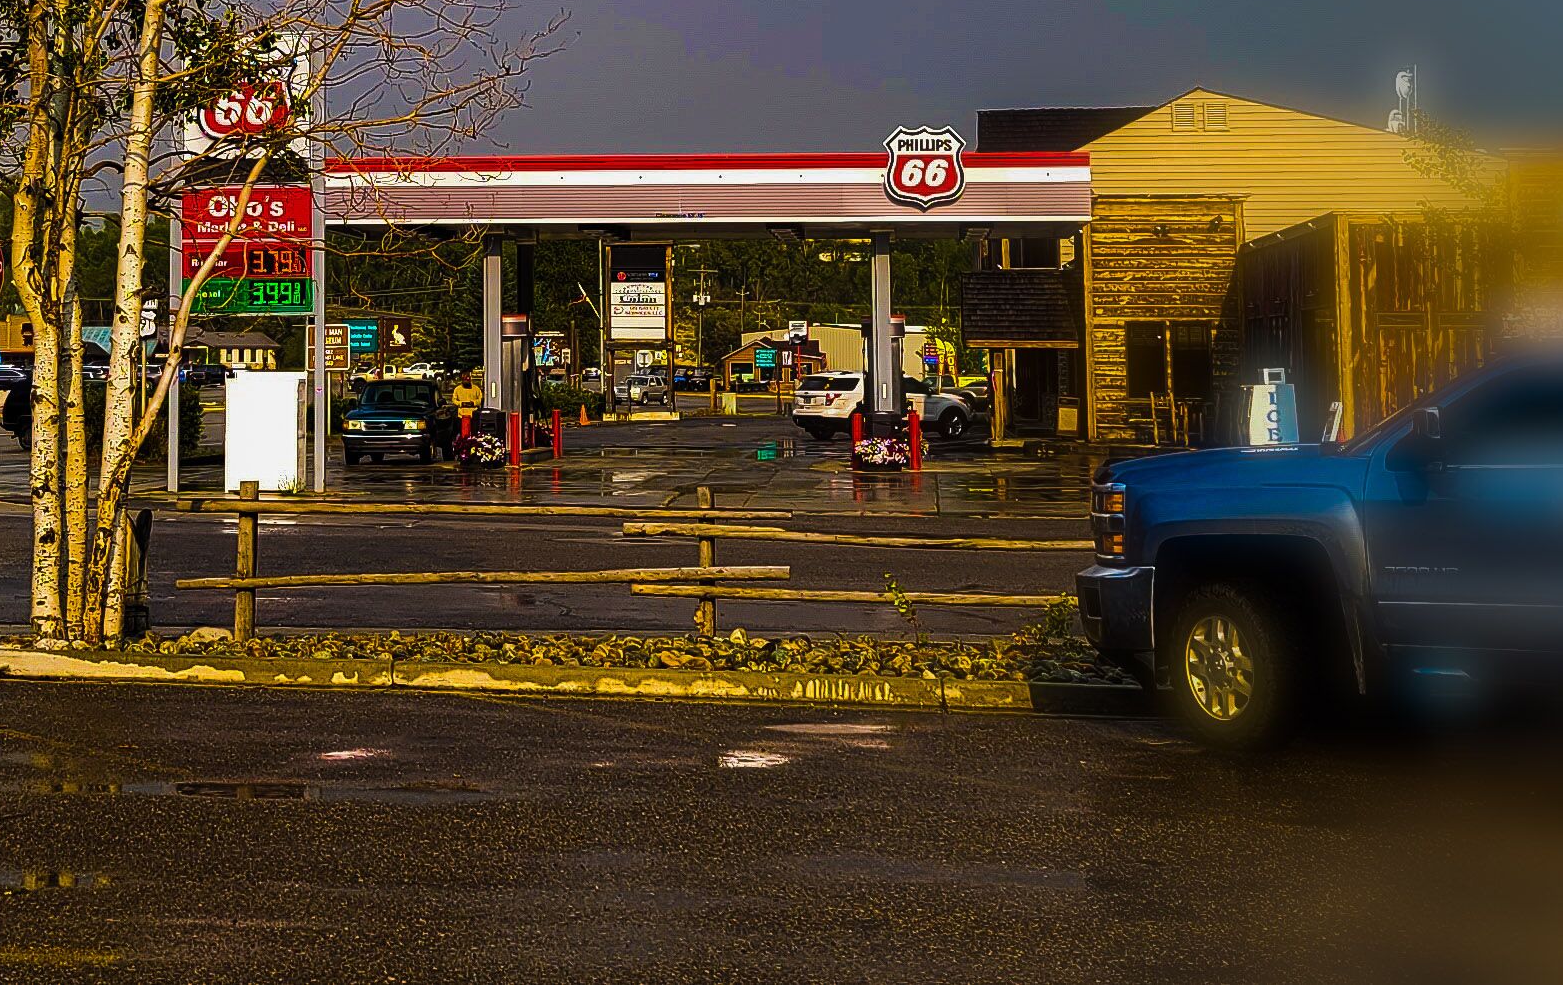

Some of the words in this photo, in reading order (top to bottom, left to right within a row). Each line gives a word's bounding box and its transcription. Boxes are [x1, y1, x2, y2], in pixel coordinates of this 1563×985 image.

[214, 90, 273, 126] 66
[897, 138, 953, 152] PHILLIPS
[901, 158, 949, 187] 66
[268, 221, 295, 232] Deli
[1266, 391, 1283, 443] ICE
